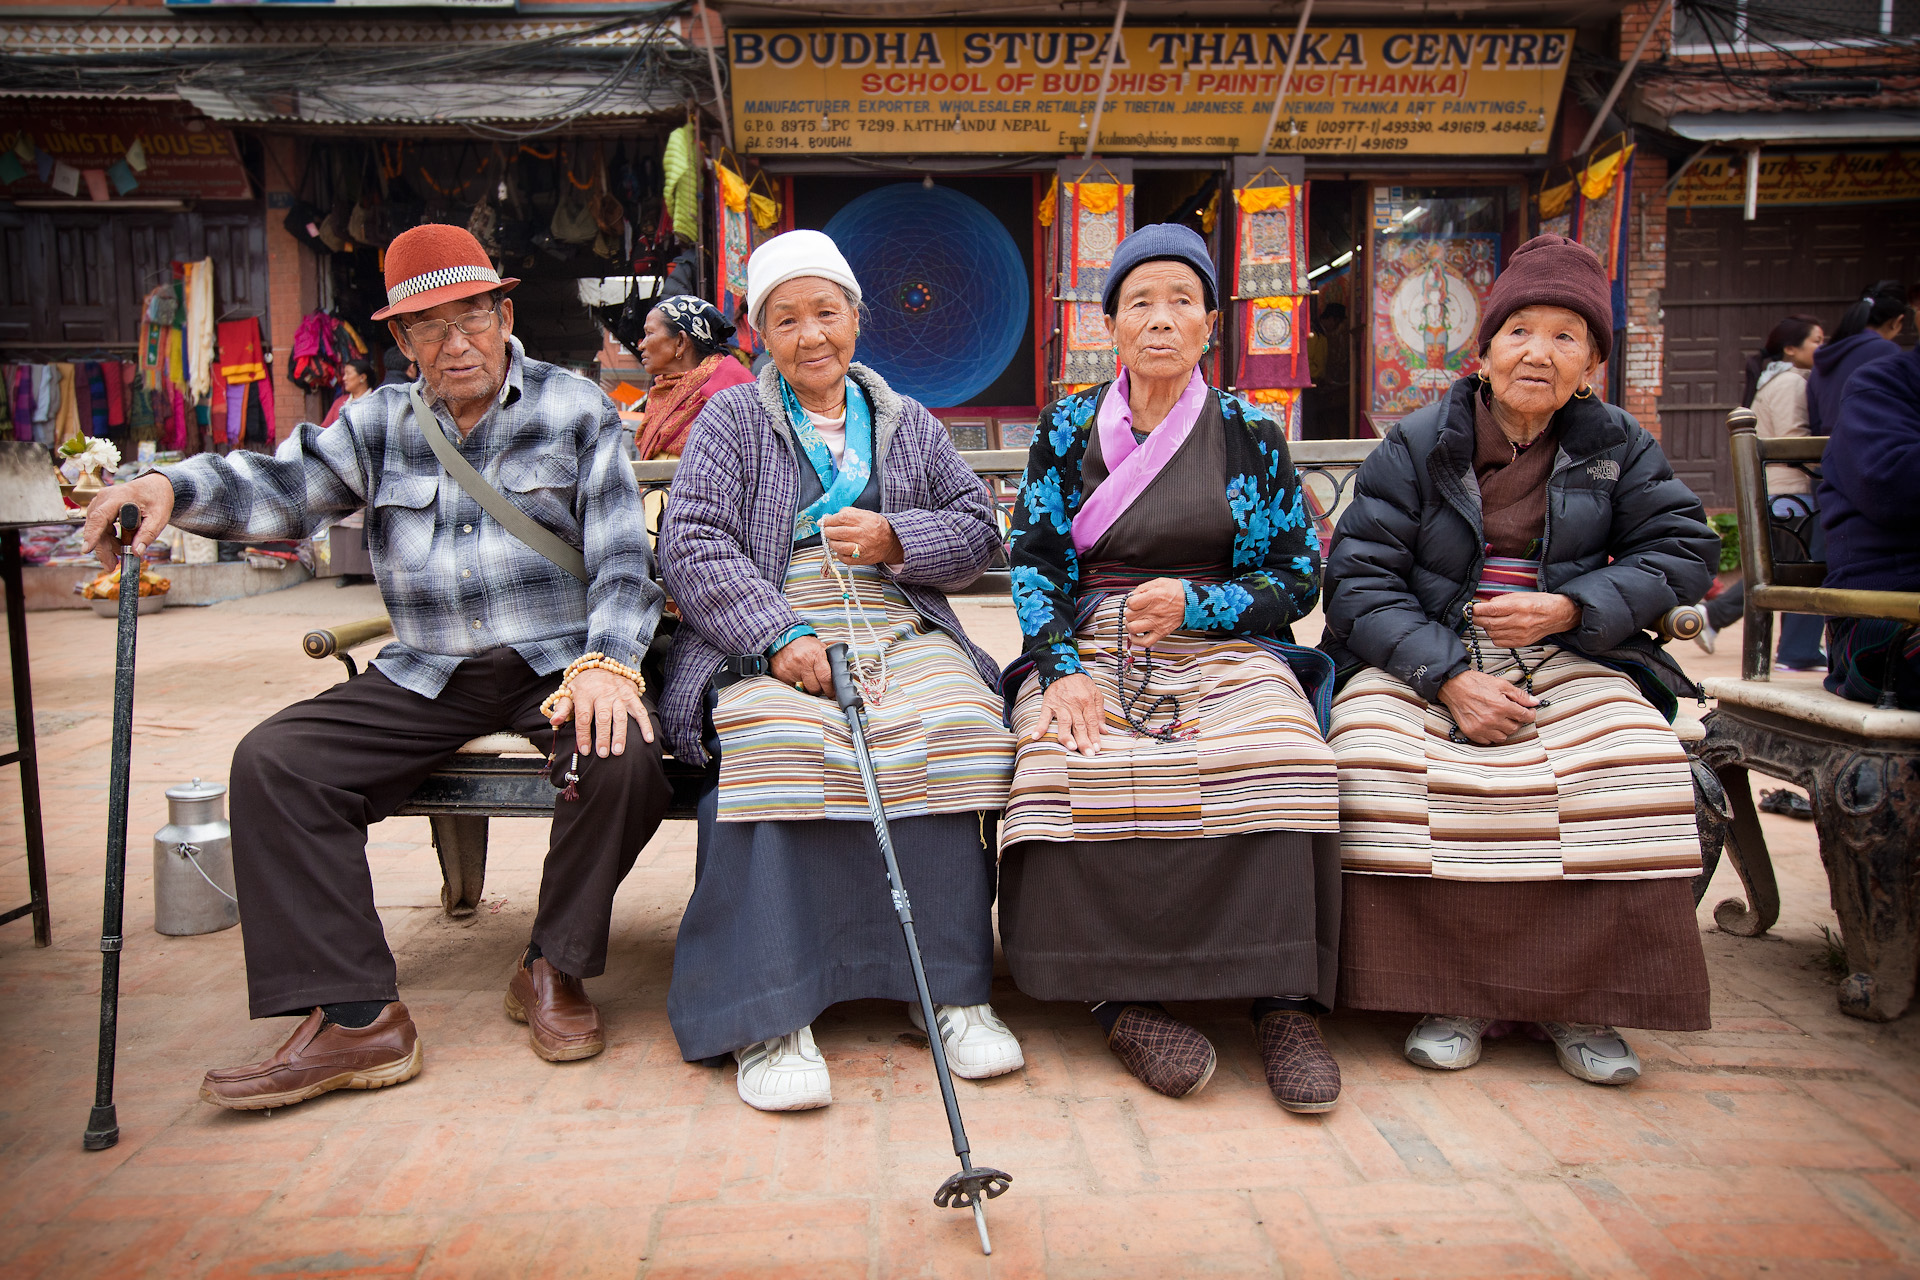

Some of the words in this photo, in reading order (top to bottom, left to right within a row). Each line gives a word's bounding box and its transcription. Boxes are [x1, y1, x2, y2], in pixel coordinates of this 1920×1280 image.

[733, 33, 944, 67] BOUDHA
[963, 33, 1128, 68] STUPA
[1149, 33, 1364, 68] THANKA
[1382, 34, 1568, 69] CENTRE
[861, 73, 989, 94] SCHOOL
[996, 73, 1035, 94] OF
[1042, 73, 1184, 94] BUDDHIST
[1102, 101, 1118, 113] OF
[1283, 102, 1335, 114] NEWARI
[1342, 102, 1398, 114] THANKA
[1405, 102, 1436, 114] ART
[1002, 120, 1051, 132] NEPAL
[1274, 121, 1308, 133] HONE
[136, 133, 229, 156] HOUSE
[1058, 131, 1091, 146] E-mai
[1360, 138, 1408, 150] 491619
[1596, 459, 1611, 467] THE
[1586, 466, 1611, 475] NORTH
[1593, 473, 1611, 481] FACE
[1412, 664, 1428, 681] 700
